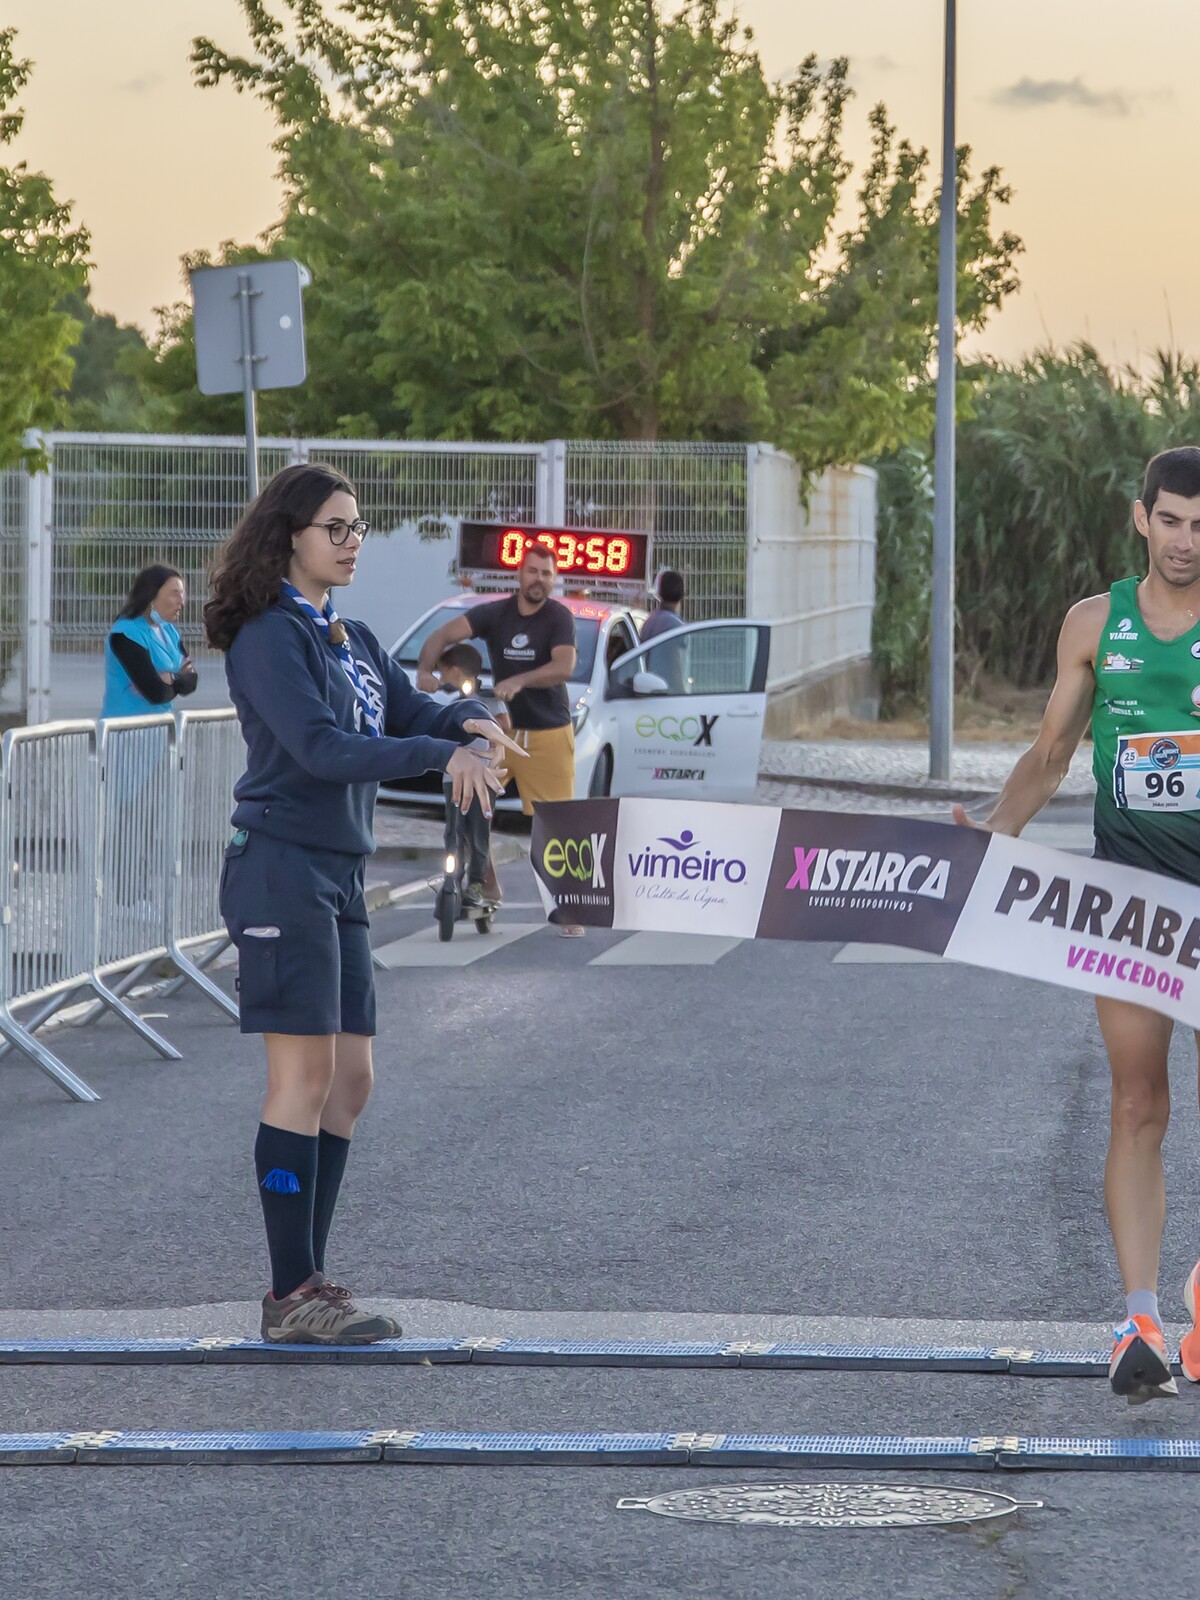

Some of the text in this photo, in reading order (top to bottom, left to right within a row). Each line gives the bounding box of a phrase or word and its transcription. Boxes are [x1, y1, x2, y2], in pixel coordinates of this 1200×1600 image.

[1109, 632, 1139, 641] VIATOR
[635, 714, 719, 747] ecoX
[1124, 751, 1136, 762] 25
[652, 767, 706, 780] XISTARCA
[1145, 771, 1185, 799] 96
[543, 833, 607, 888] ecoX
[628, 846, 747, 883] vimeiro
[785, 846, 951, 900] XISTARCA
[809, 896, 914, 914] EVENTOS DESPORTIVOS
[1066, 945, 1184, 1001] VENCEDOR
